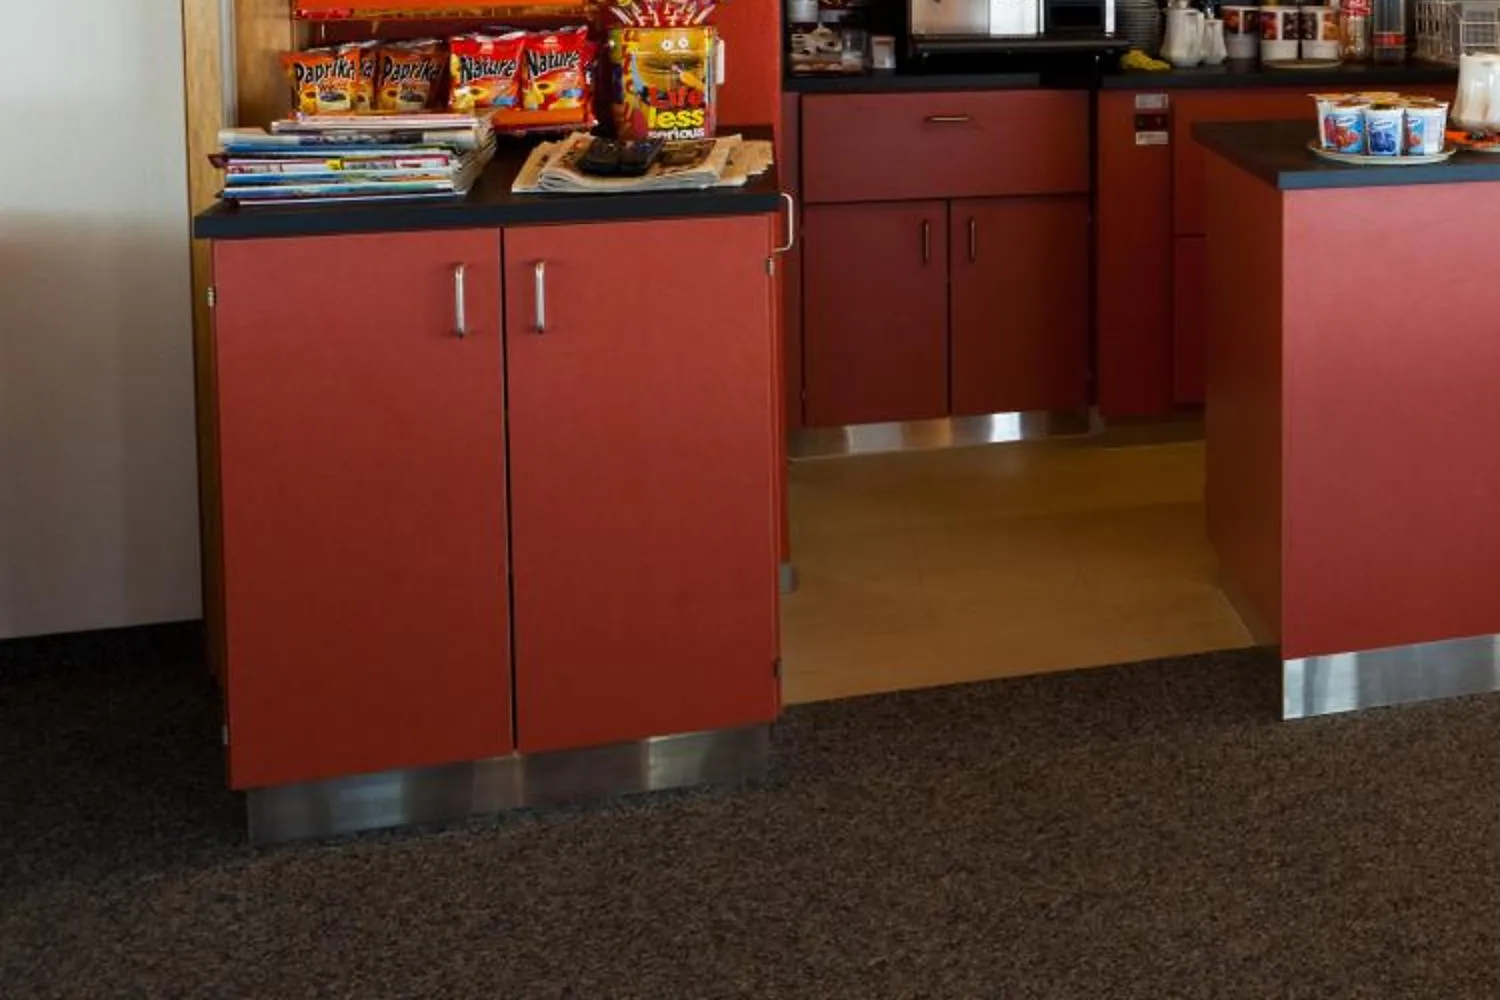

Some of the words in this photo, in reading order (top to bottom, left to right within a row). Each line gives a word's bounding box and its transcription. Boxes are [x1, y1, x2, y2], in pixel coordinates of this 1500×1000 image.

[460, 55, 517, 86] Nature
[526, 49, 580, 77] Nature
[648, 107, 704, 129] less
